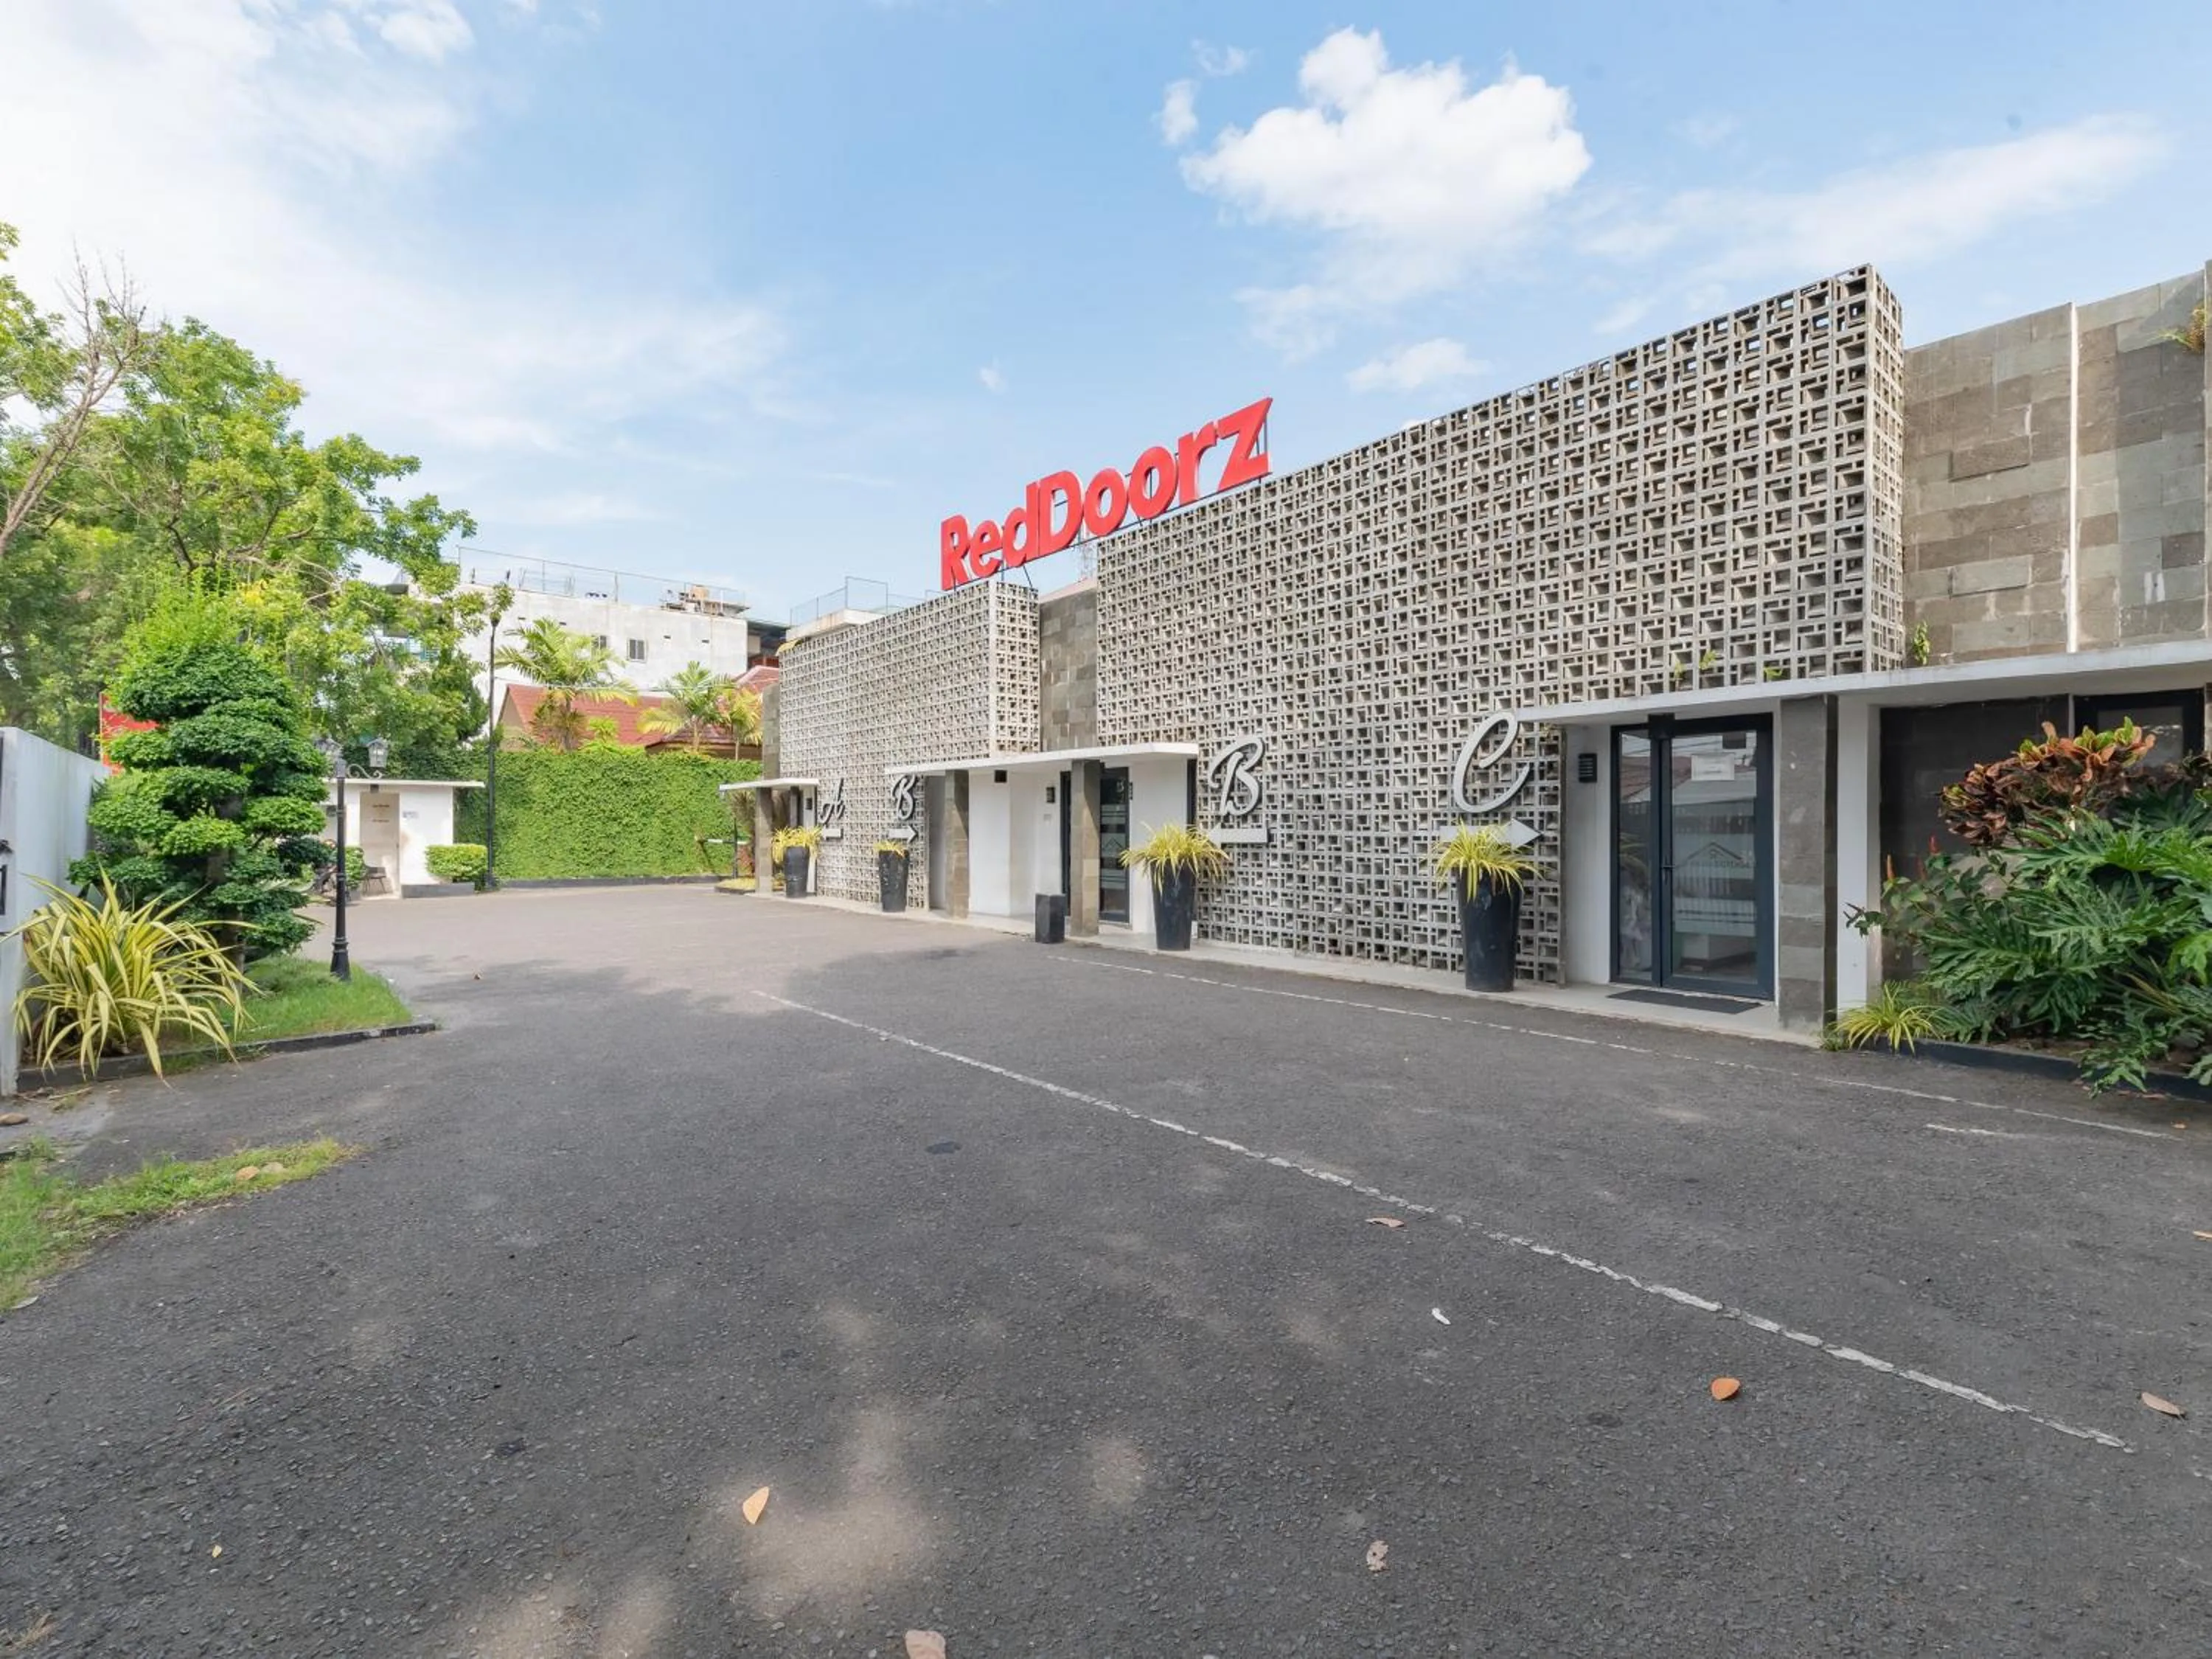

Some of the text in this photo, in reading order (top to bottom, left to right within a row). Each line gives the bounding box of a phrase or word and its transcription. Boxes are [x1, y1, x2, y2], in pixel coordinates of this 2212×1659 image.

[941, 397, 1273, 591] RedDoorz
[891, 773, 917, 821] B
[1209, 737, 1264, 816] B
[1455, 712, 1530, 812] C
